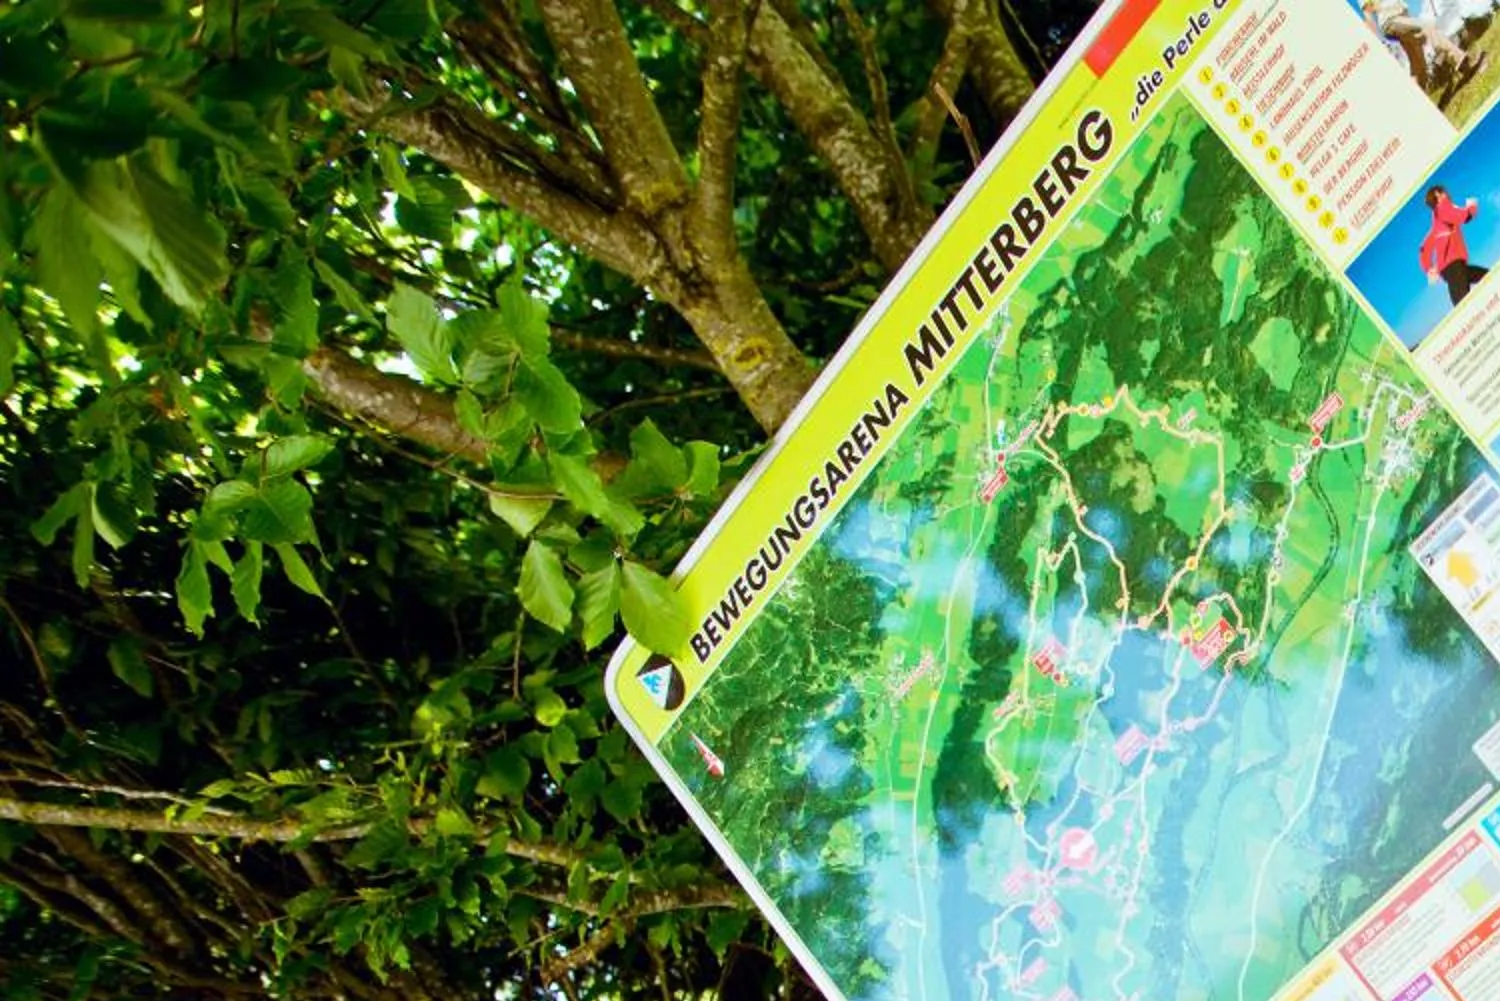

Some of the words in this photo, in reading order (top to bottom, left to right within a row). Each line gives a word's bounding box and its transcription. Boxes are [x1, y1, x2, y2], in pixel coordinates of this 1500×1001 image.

[691, 384, 908, 661] BEWEGUNGSARENA
[905, 111, 1111, 384] MITTERBERG
[1163, 12, 1211, 69] Perle
